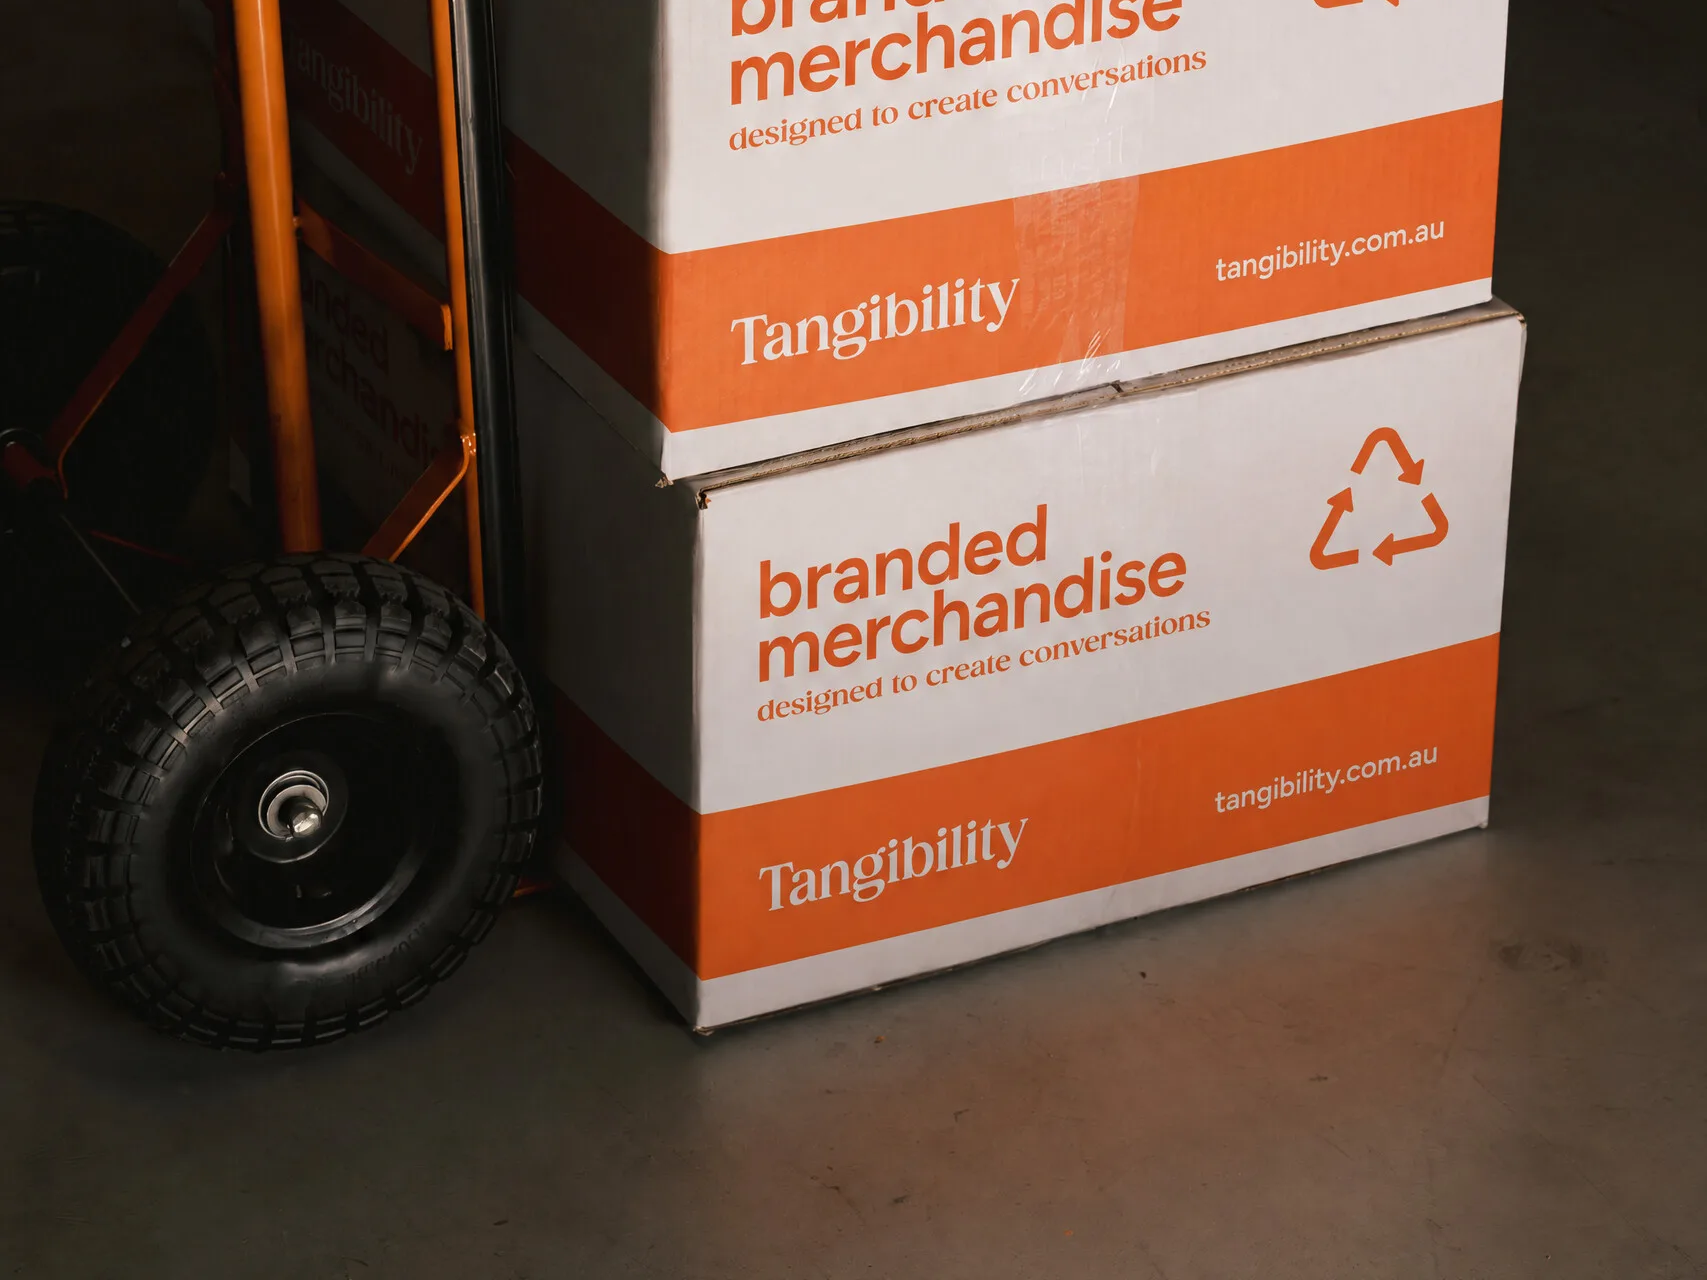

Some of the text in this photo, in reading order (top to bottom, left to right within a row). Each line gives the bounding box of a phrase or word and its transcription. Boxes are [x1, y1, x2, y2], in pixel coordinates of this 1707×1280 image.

[729, 51, 1207, 151] designed to create conversations
[1215, 221, 1445, 281] tangibility.com.au
[731, 277, 1020, 366] Tangibility
[760, 504, 1047, 618] branded
[759, 550, 1187, 682] merchandise
[757, 612, 1211, 722] designed to create conversations
[1215, 747, 1437, 813] tangibility.com.au
[759, 819, 1029, 910] Tangibility
